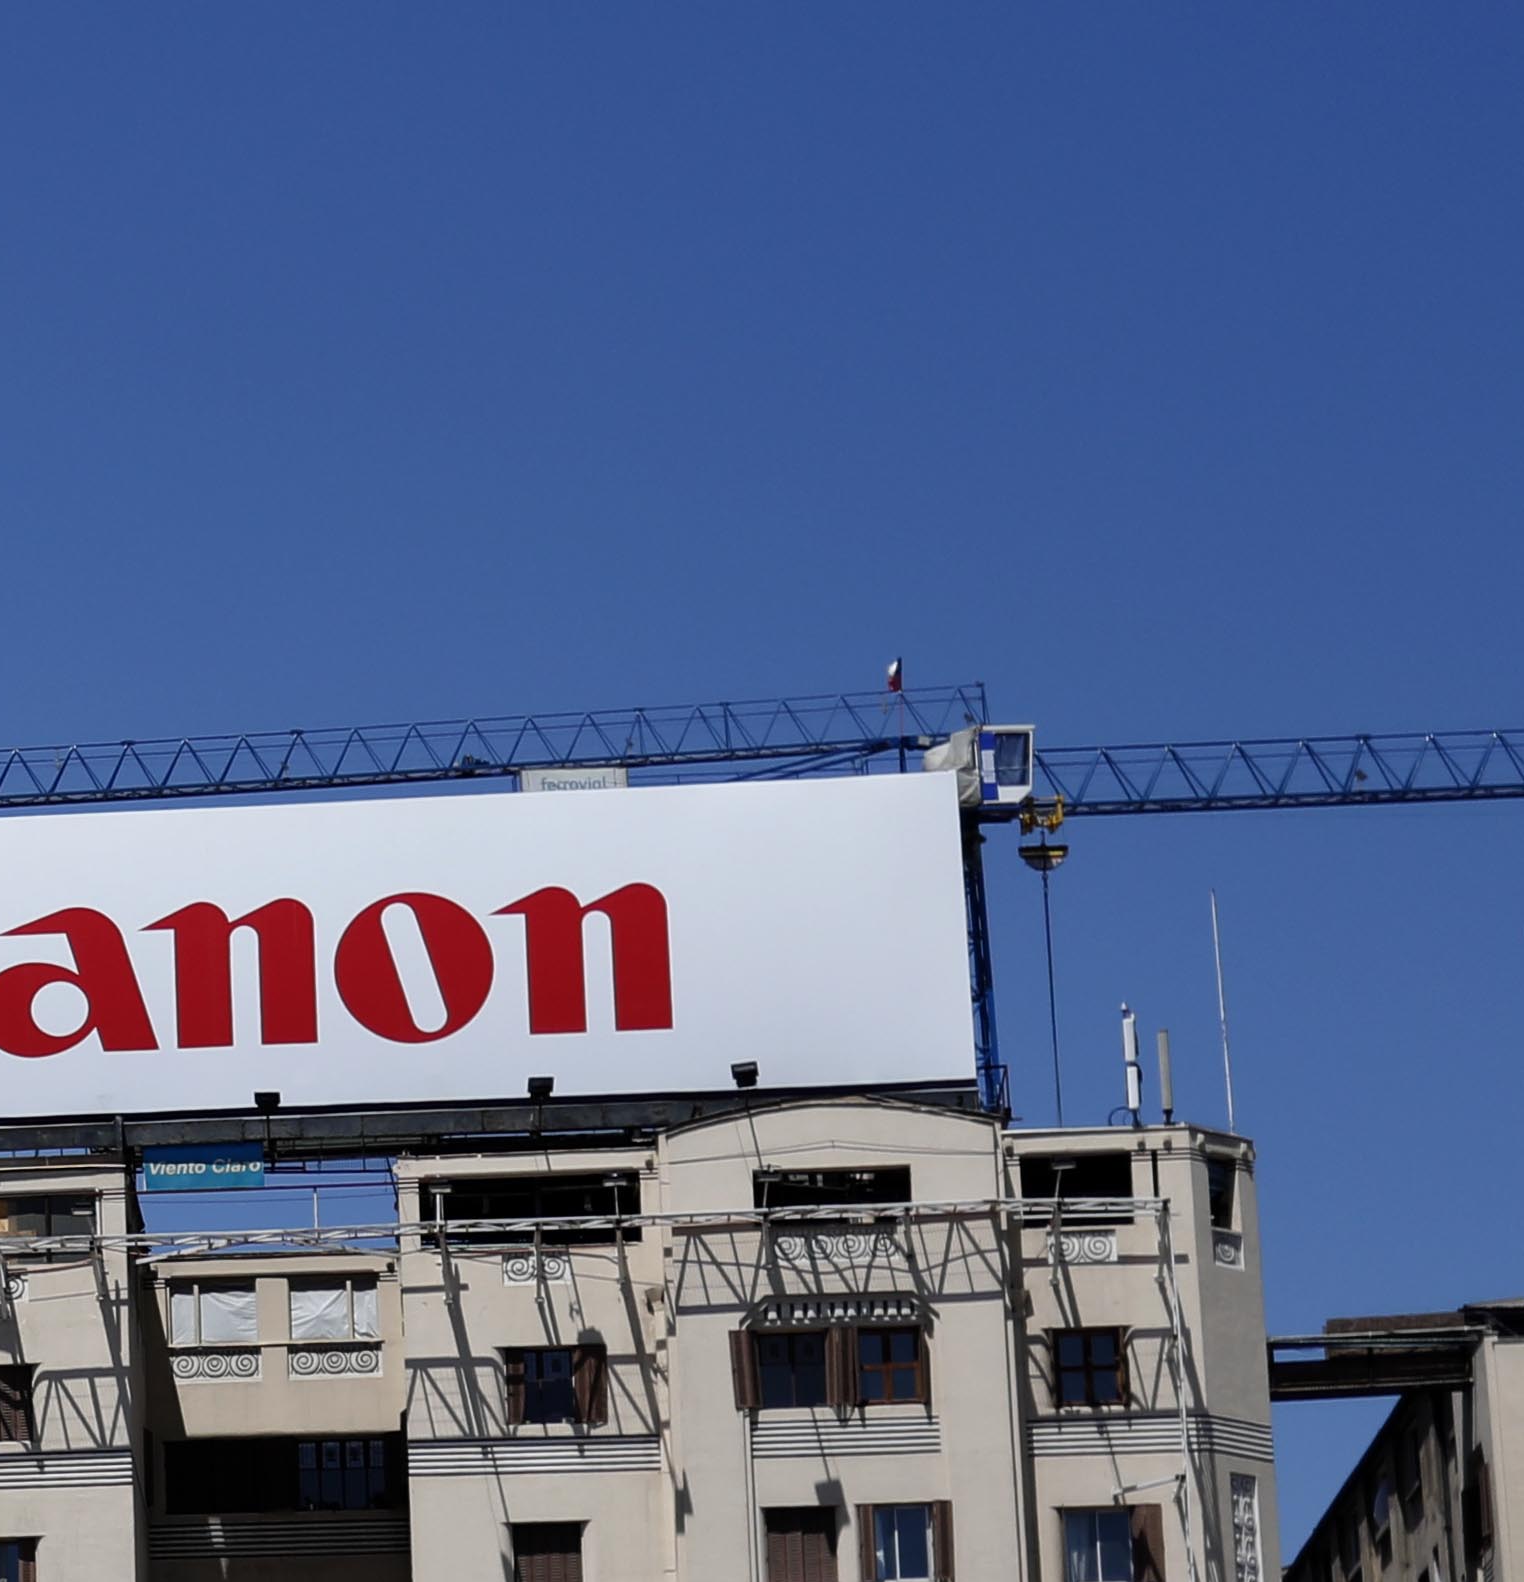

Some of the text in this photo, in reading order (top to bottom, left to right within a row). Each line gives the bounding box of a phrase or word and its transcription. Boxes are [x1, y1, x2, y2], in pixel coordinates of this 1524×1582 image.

[542, 776, 606, 790] ferrovial
[149, 1159, 261, 1175] Viento Claro
